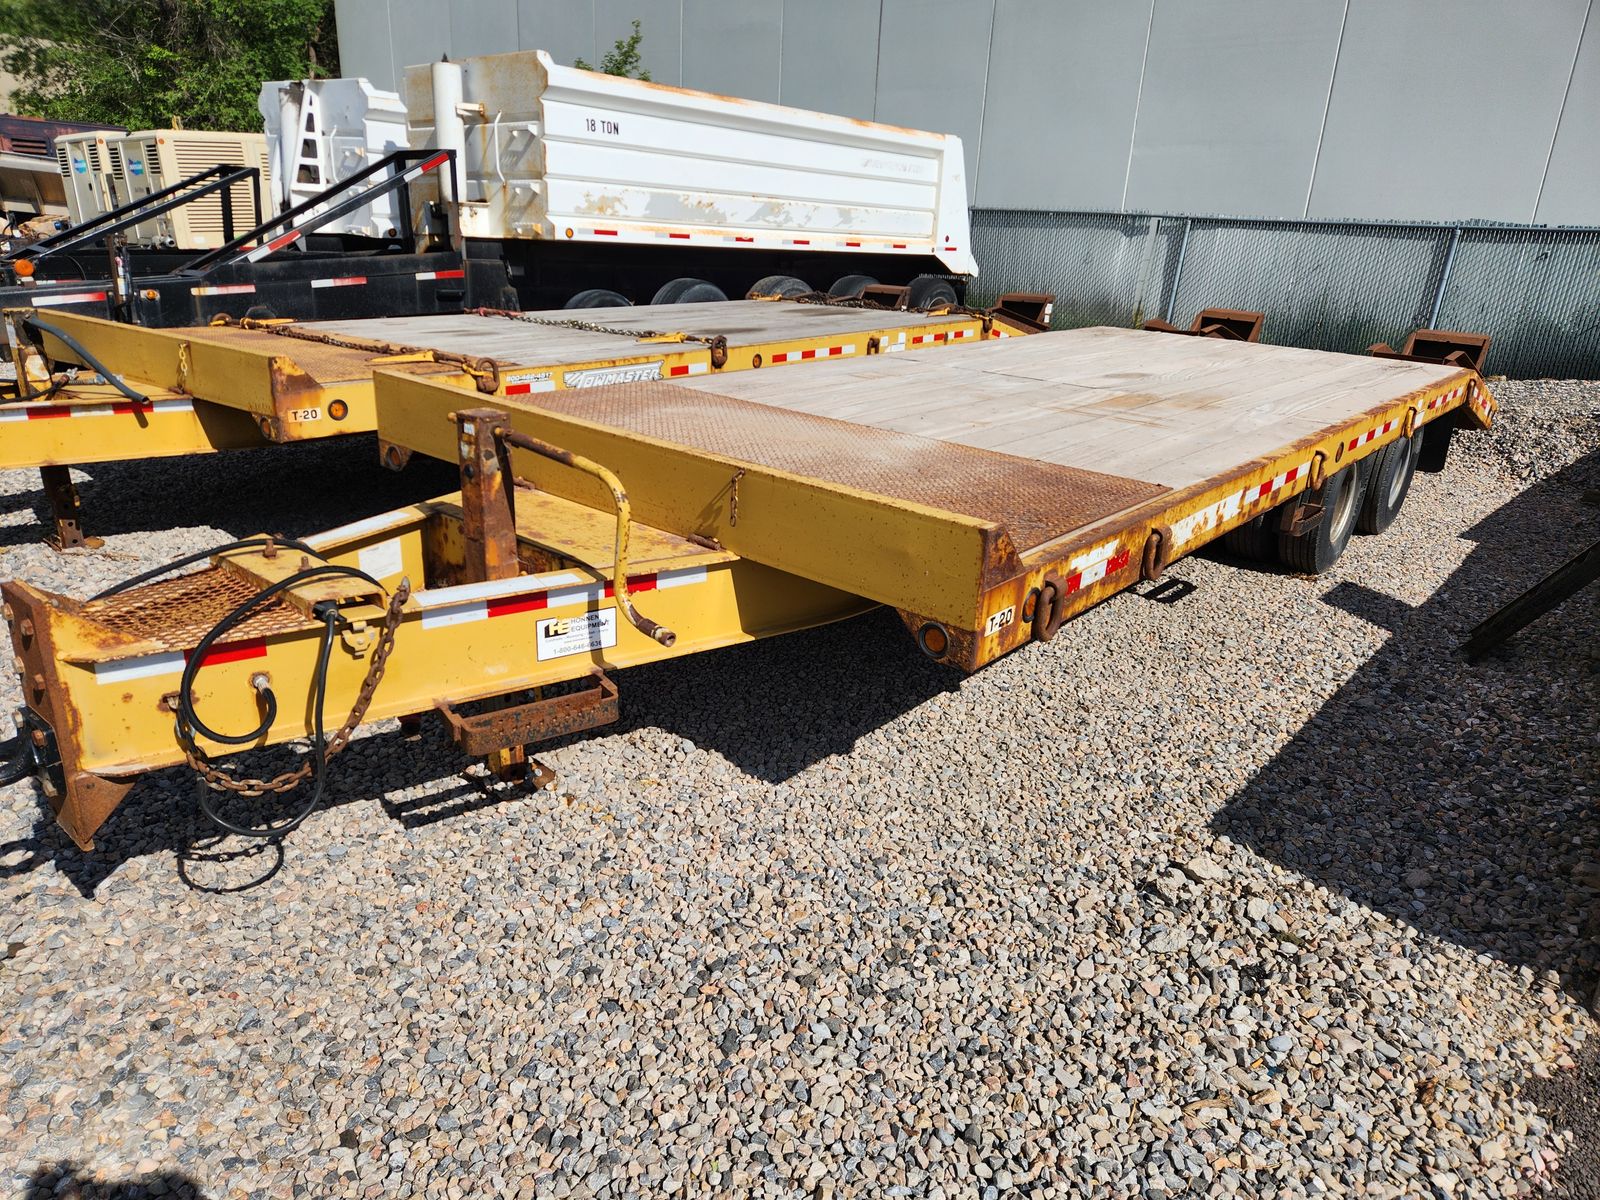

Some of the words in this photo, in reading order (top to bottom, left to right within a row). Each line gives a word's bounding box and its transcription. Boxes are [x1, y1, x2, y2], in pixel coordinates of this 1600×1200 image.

[586, 118, 596, 132] 18
[600, 120, 619, 135] TON
[292, 409, 318, 421] T-20
[570, 614, 599, 625] HONNEN
[990, 608, 1012, 632] T-20
